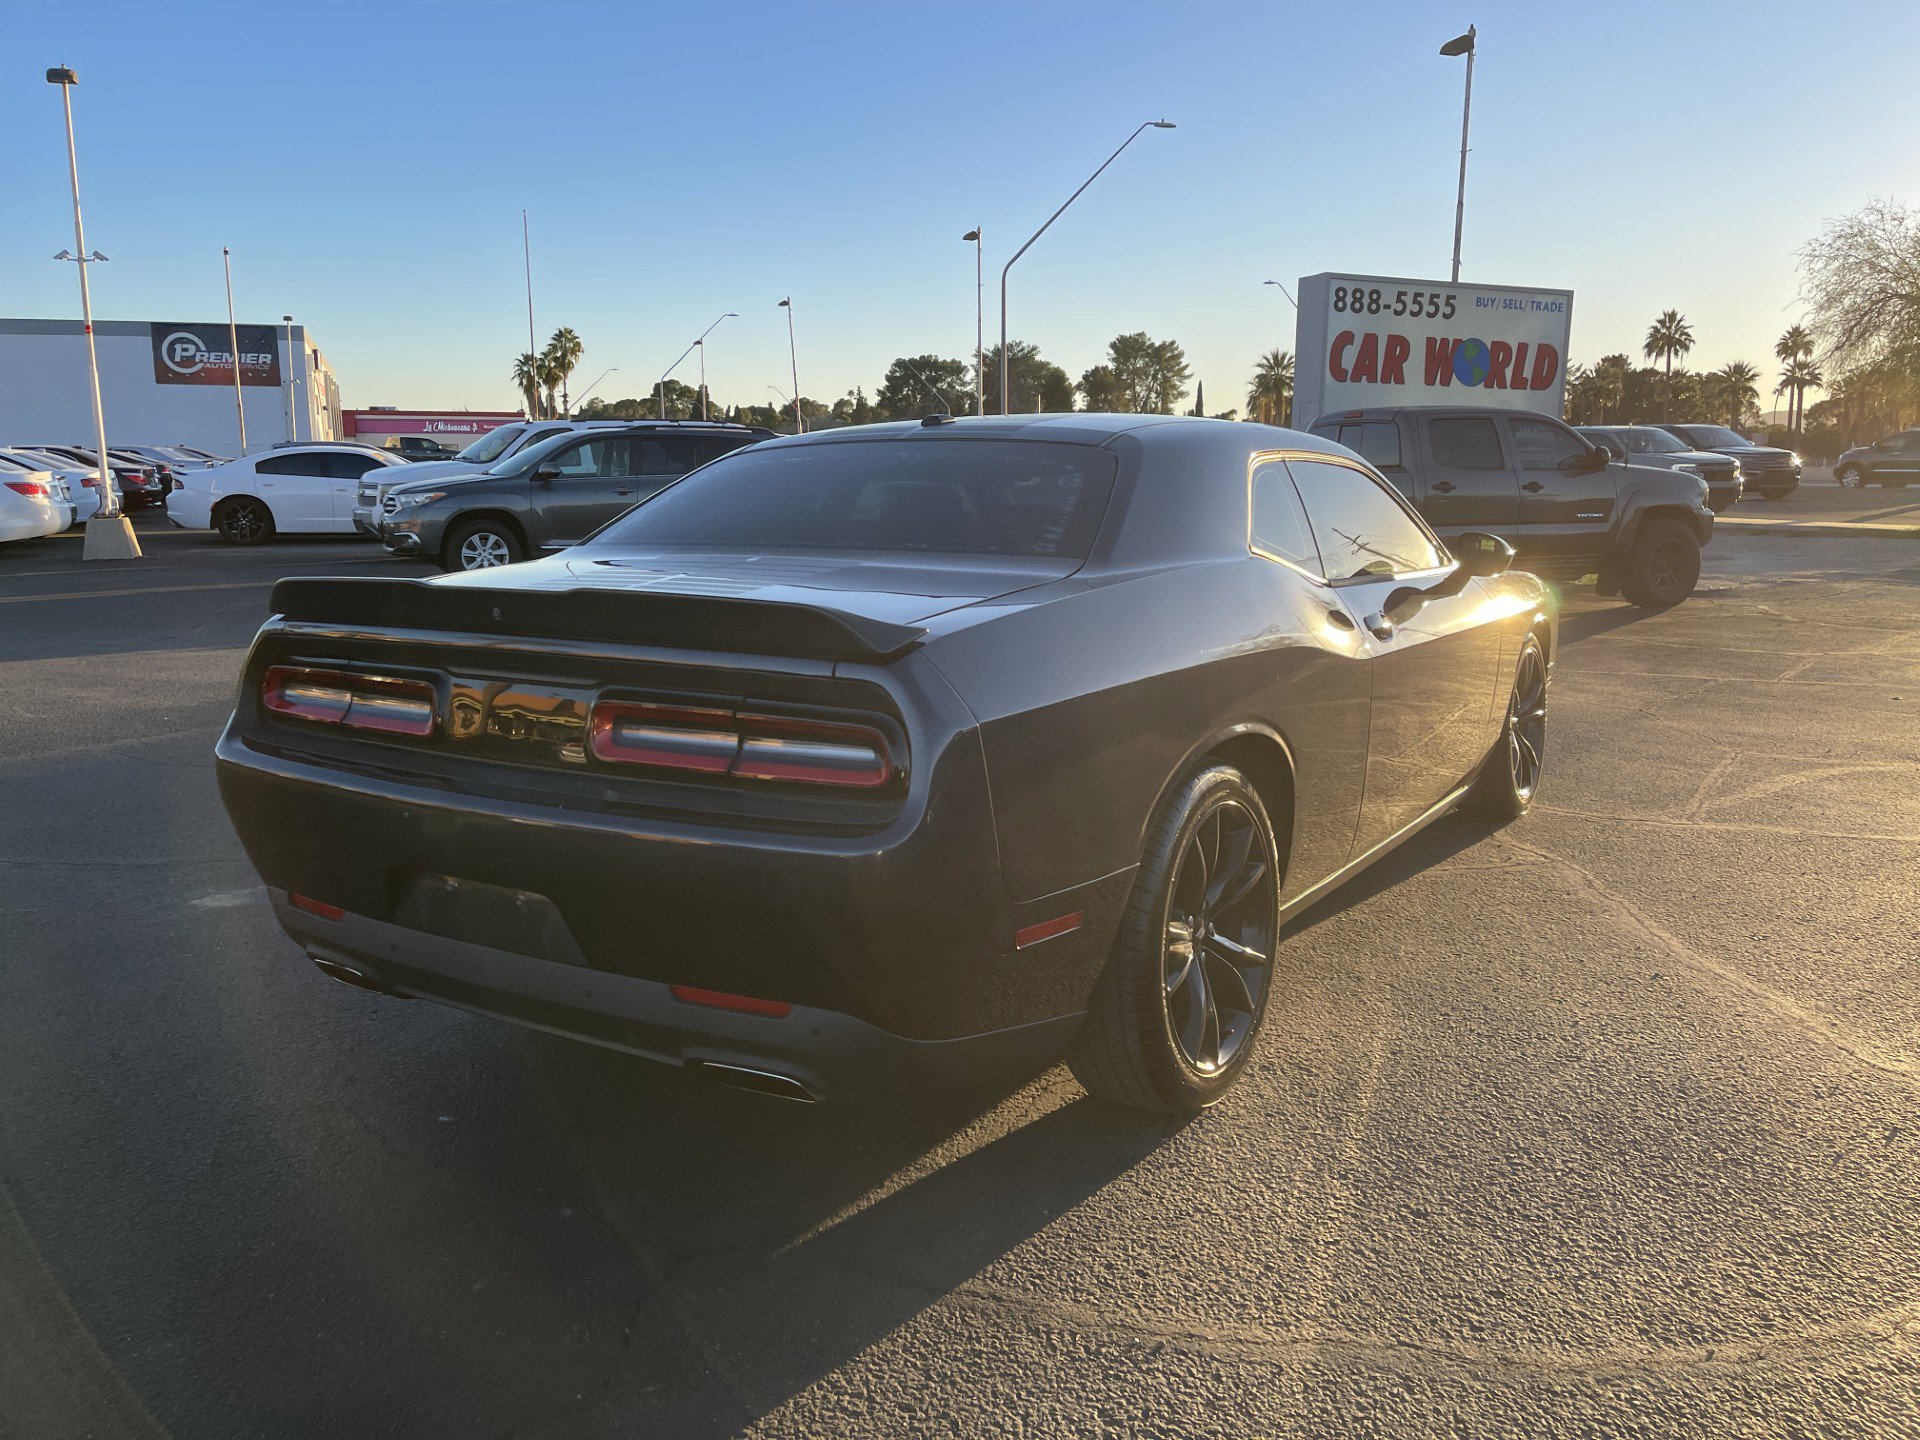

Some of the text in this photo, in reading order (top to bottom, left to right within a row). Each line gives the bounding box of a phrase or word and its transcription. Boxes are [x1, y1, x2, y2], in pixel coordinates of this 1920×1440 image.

[1333, 286, 1457, 319] 888-5555
[174, 343, 272, 364] PREMIER
[1329, 330, 1559, 391] CAR WORLD
[423, 421, 432, 433] La
